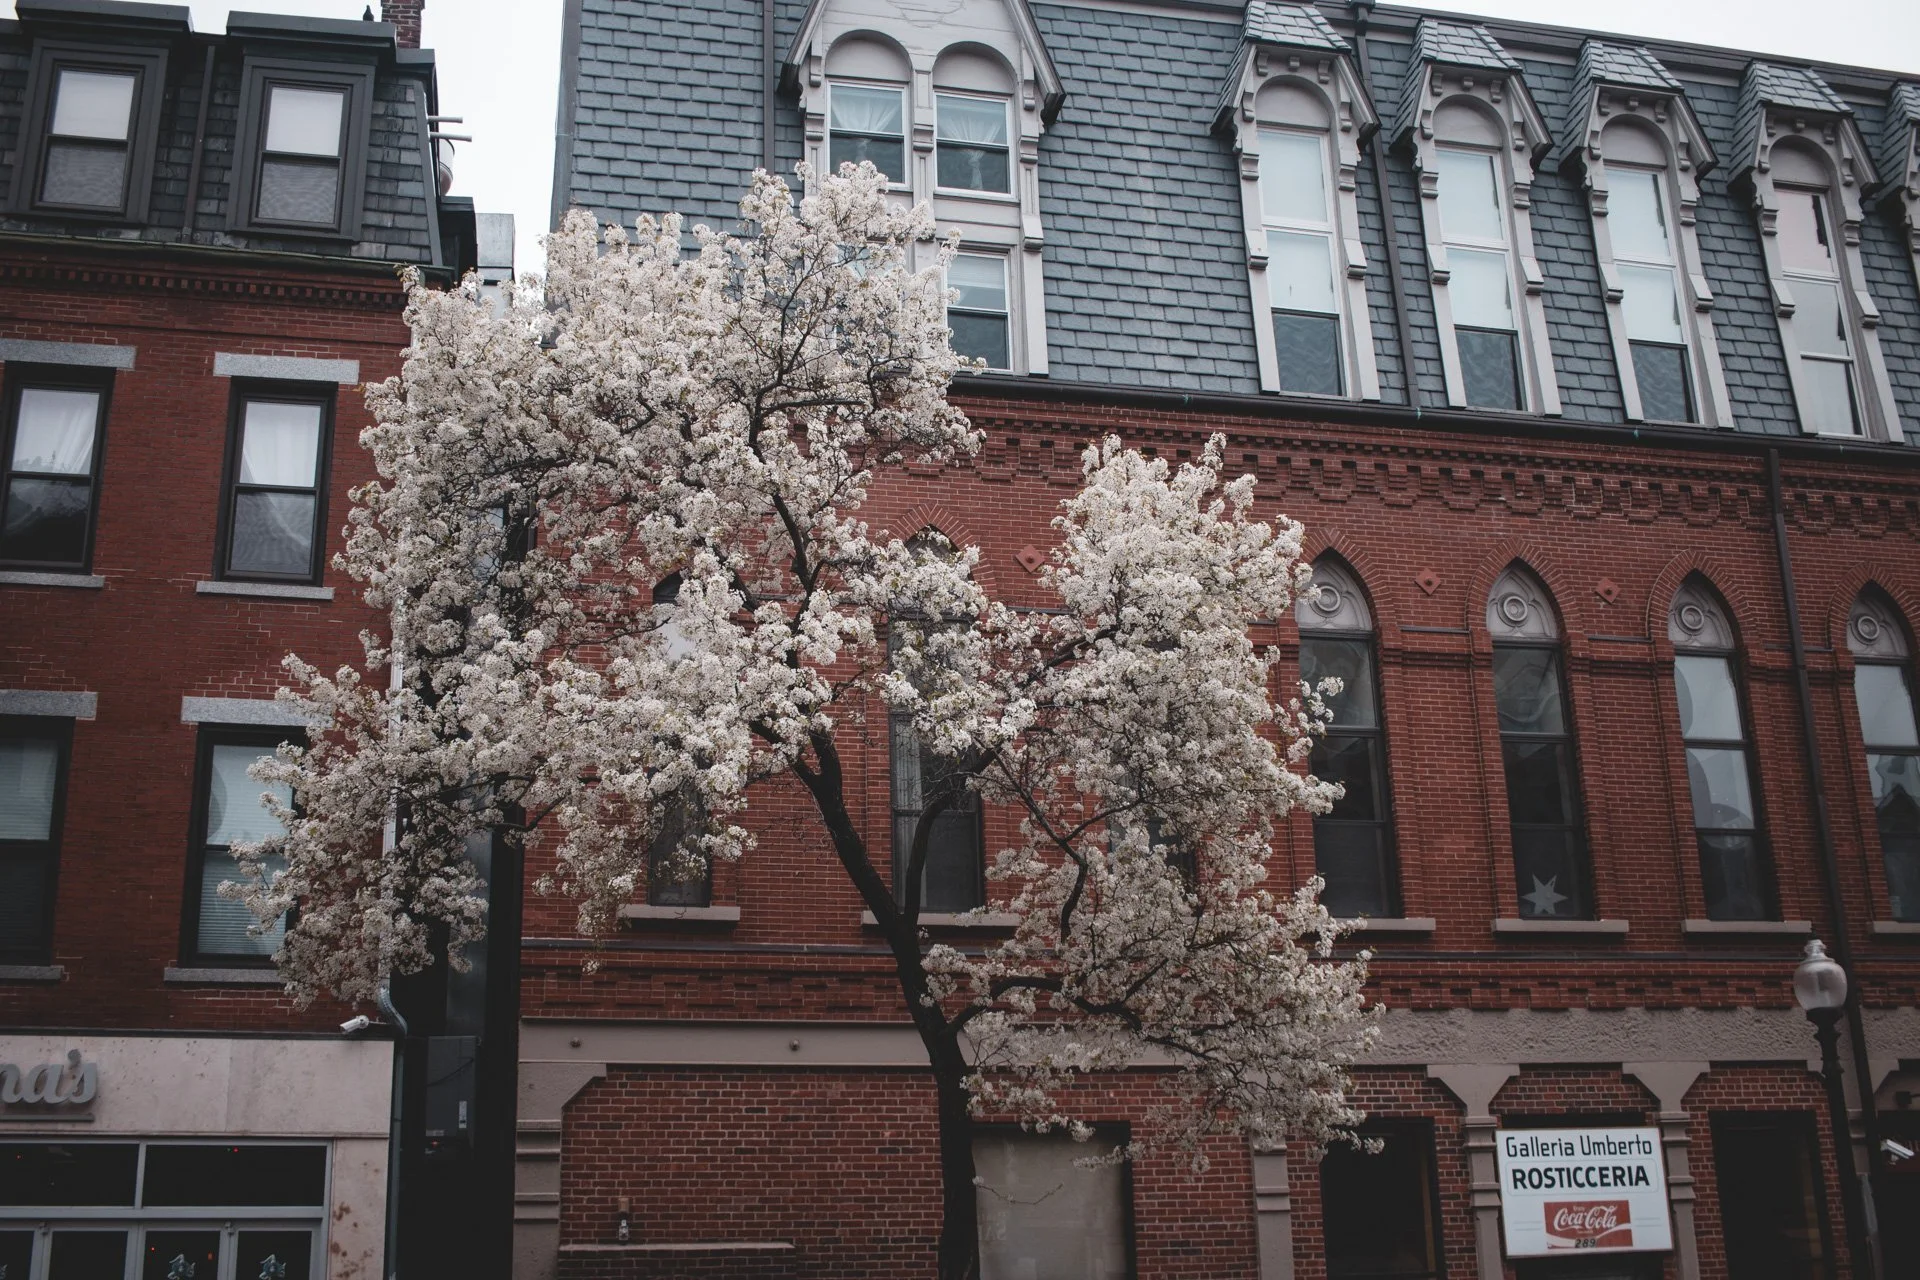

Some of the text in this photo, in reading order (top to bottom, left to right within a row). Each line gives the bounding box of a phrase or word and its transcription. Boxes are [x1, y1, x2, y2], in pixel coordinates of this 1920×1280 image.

[1506, 1134, 1652, 1157] Galleria Umberto
[1512, 1165, 1650, 1190] ROSTICCERIA
[1553, 1205, 1618, 1231] Coca-Cola
[1574, 1238, 1596, 1249] 289
